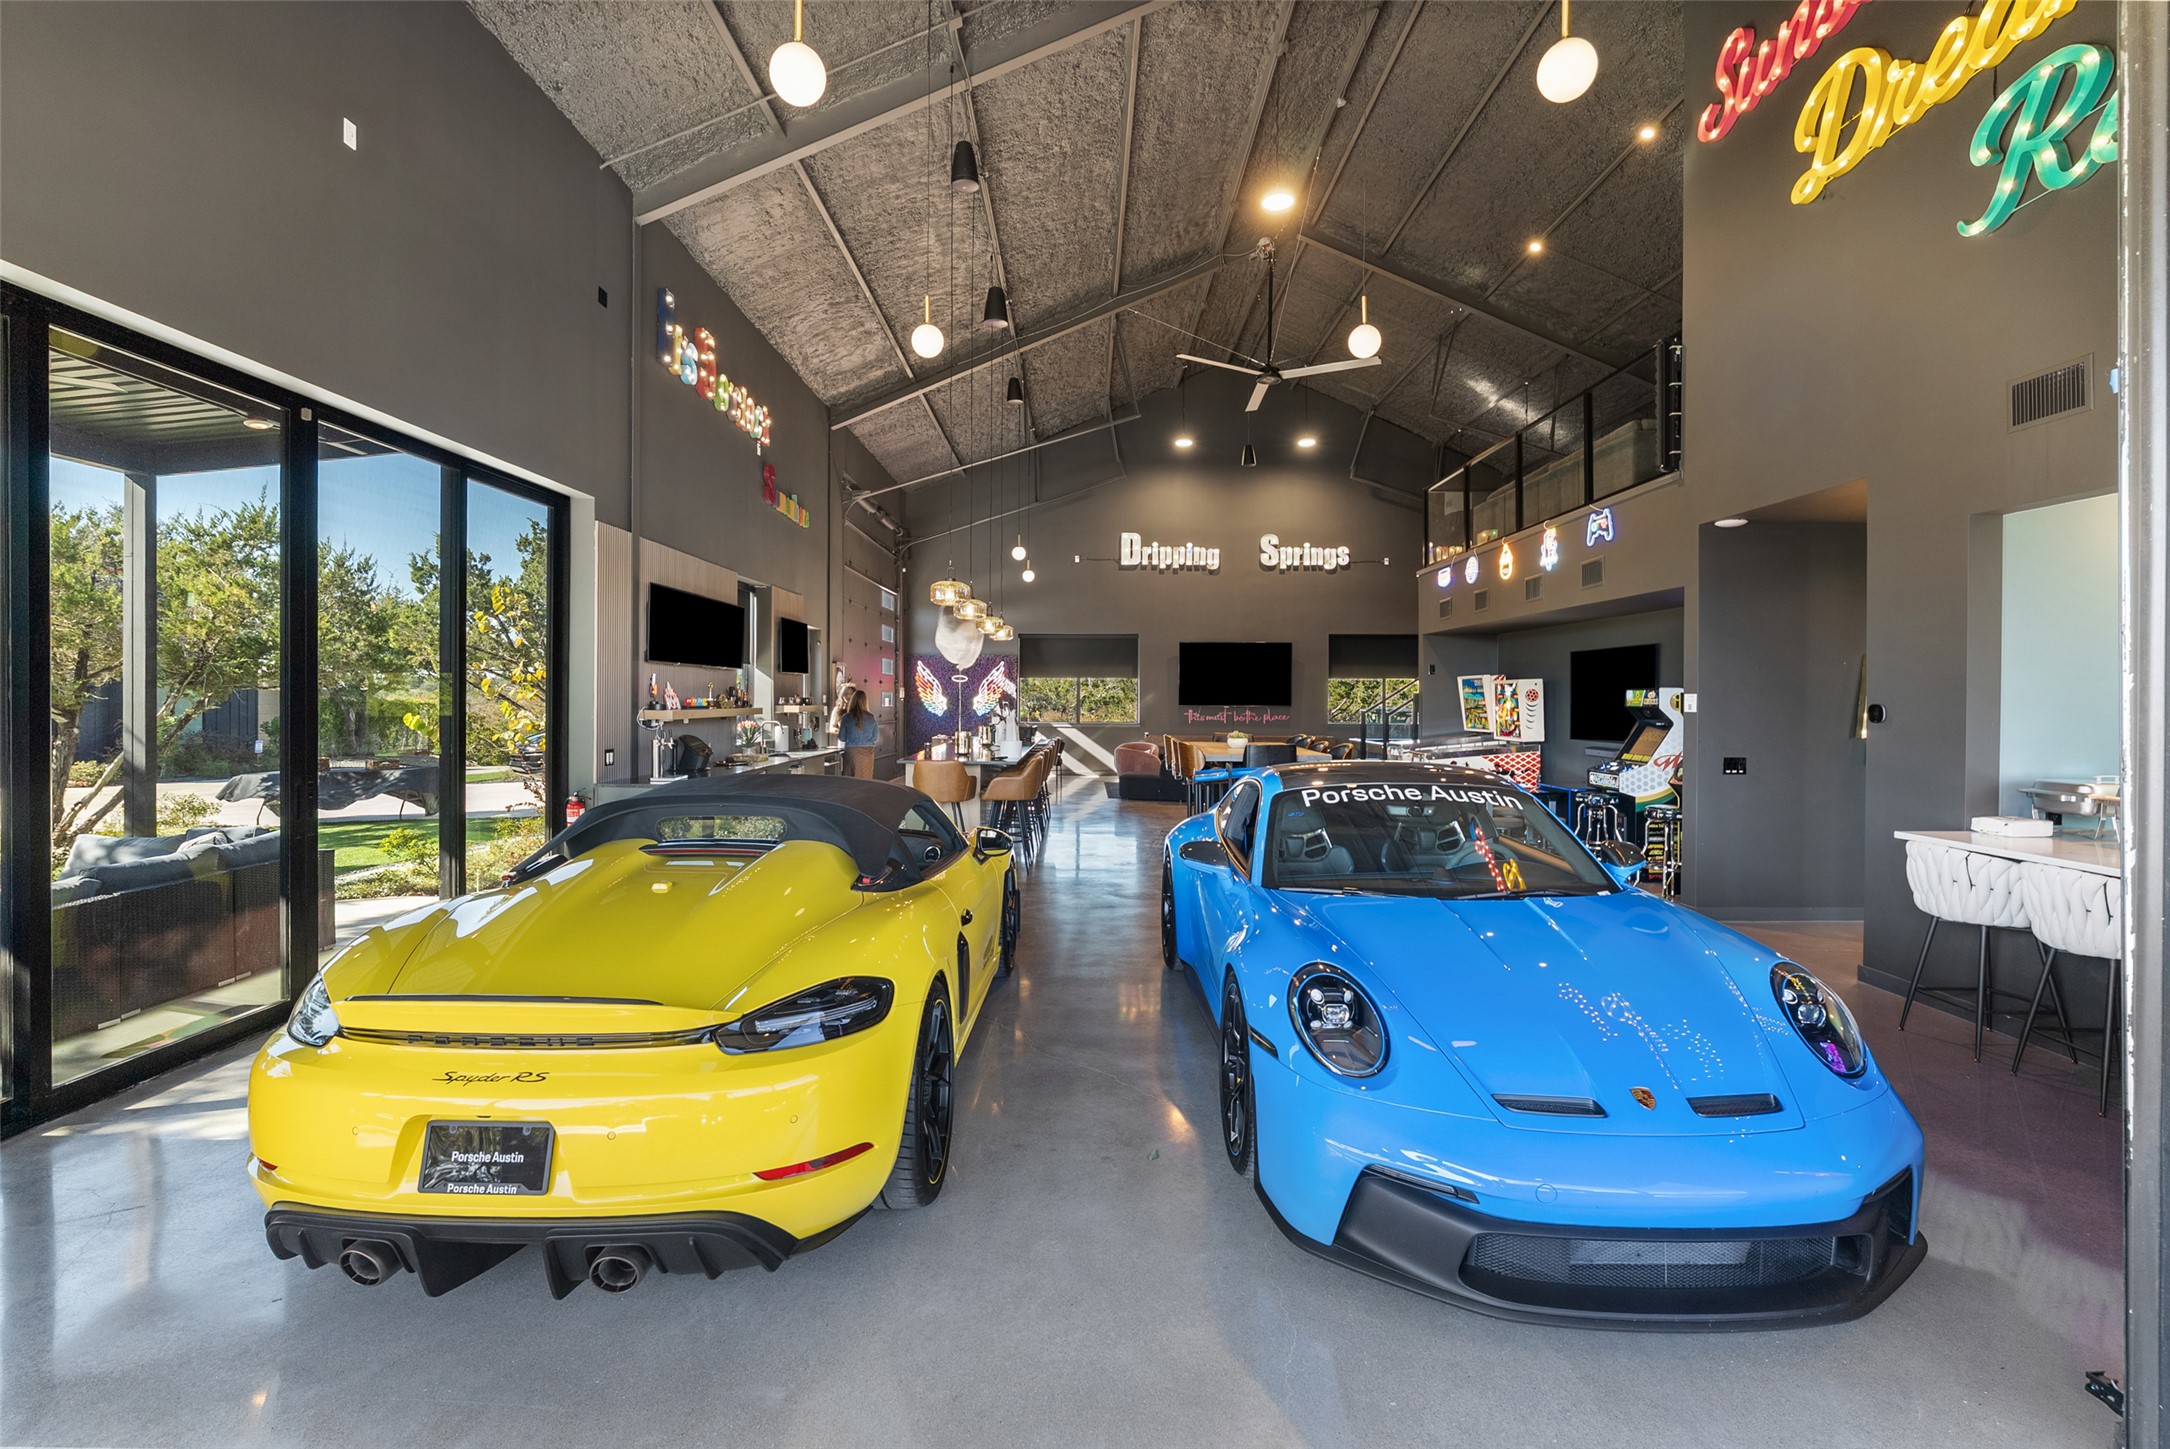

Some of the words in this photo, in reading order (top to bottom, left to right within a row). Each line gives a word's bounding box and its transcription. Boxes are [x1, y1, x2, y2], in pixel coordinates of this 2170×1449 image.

[1120, 532, 1220, 570] Dripping
[1259, 533, 1351, 570] Springs
[1262, 708, 1290, 724] place
[1301, 784, 1423, 807] Porsche
[1431, 785, 1524, 810] Austin
[407, 1035, 595, 1047] PORSCHE
[432, 1071, 511, 1087] Spyder
[510, 1071, 550, 1083] RS
[451, 1151, 491, 1163] Porsche
[492, 1151, 524, 1163] Austin
[447, 1183, 486, 1194] Porsche
[486, 1183, 517, 1195] Austin
